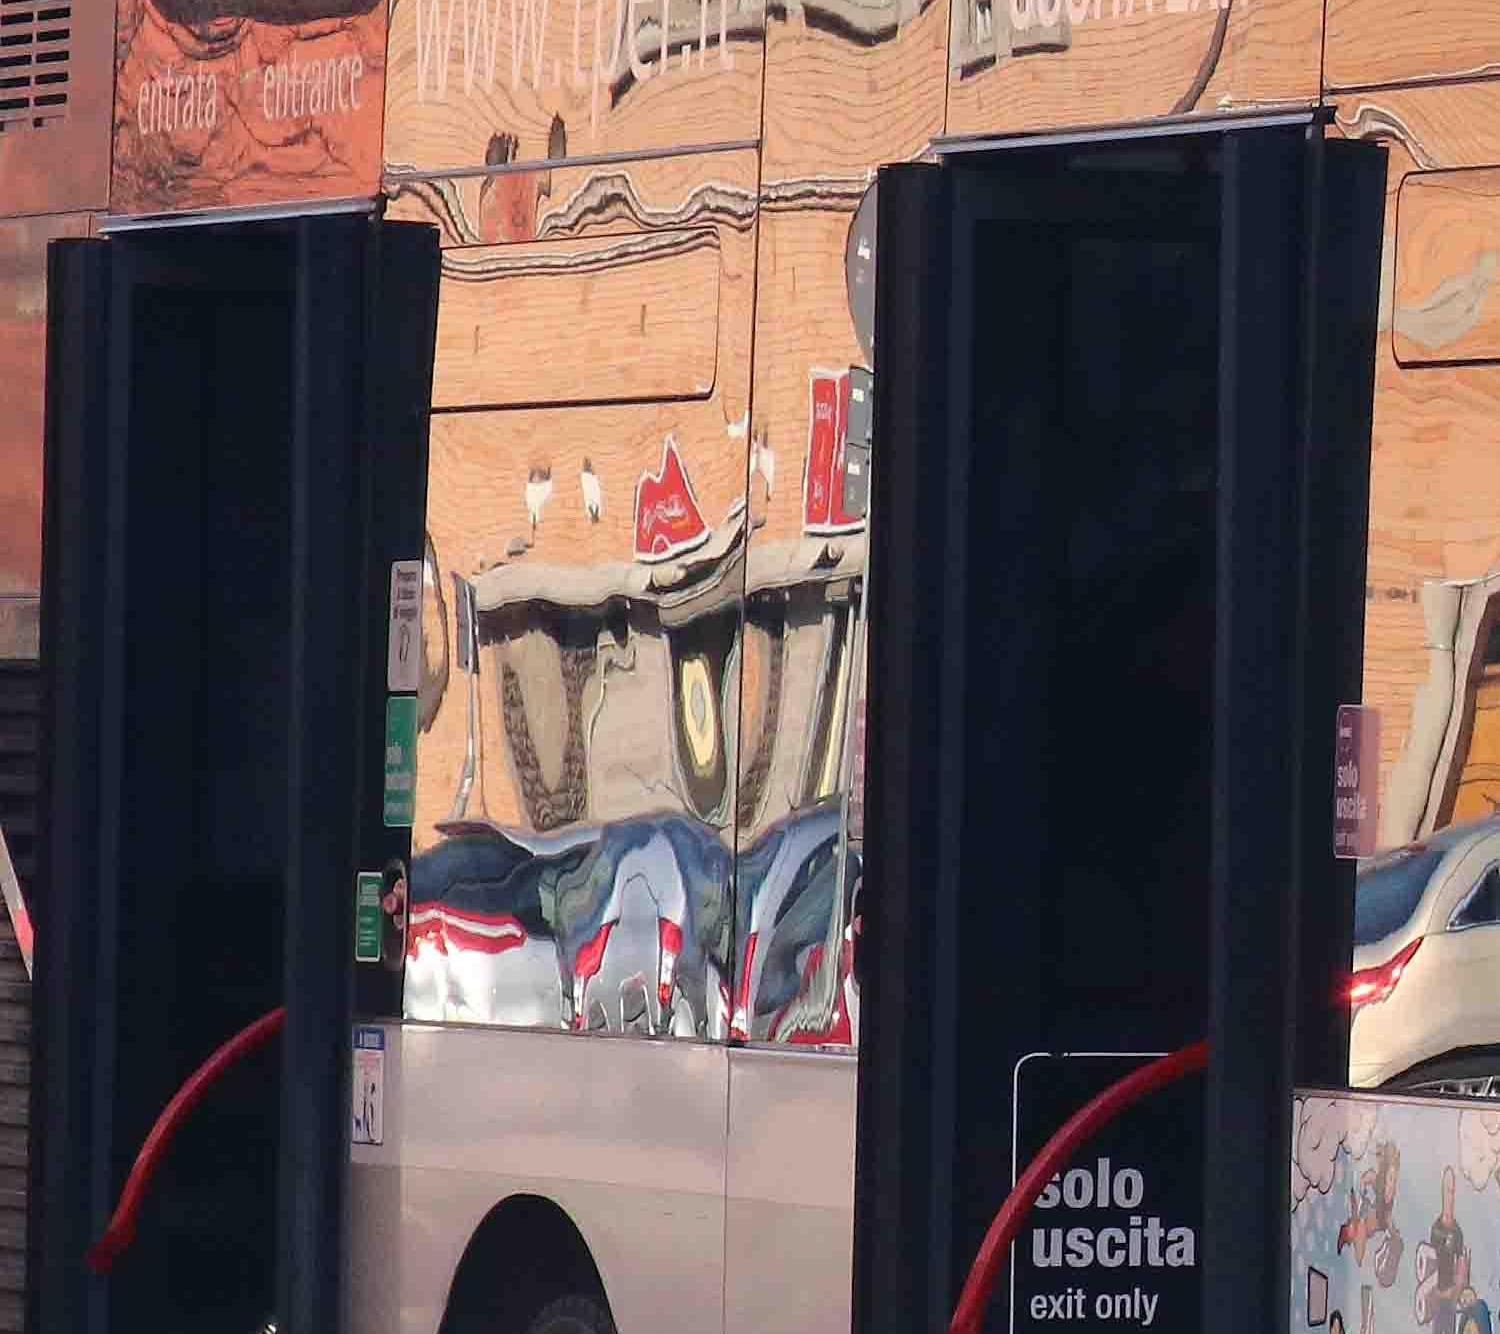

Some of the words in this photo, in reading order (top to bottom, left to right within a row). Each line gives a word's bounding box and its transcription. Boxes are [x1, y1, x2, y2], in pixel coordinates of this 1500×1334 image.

[137, 61, 219, 137] entrata
[262, 47, 364, 124] entrance
[1034, 1157, 1144, 1209] solo
[1032, 1216, 1195, 1268] uscita
[1030, 1289, 1086, 1321] exit
[1096, 1287, 1159, 1326] only
